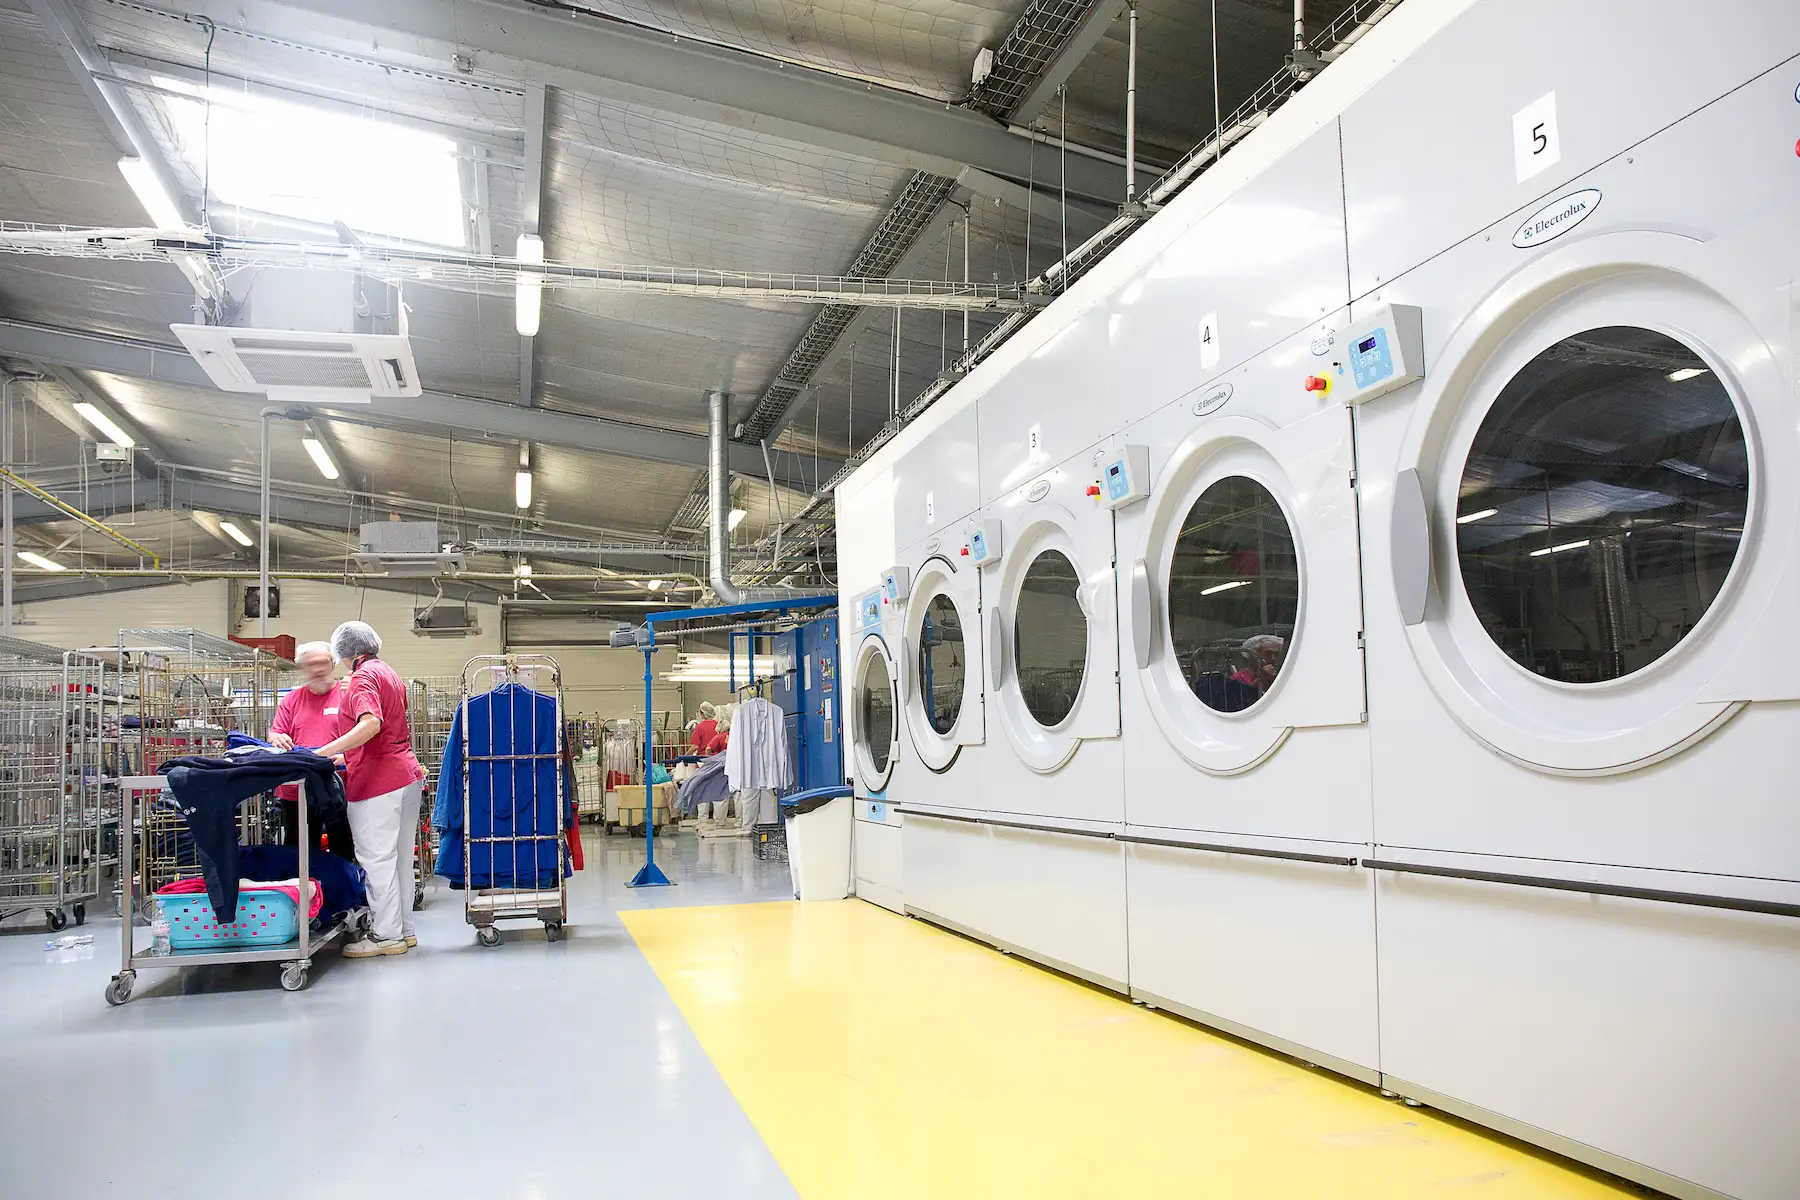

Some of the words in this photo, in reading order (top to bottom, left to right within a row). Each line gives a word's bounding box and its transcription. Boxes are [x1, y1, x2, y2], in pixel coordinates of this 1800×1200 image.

[1533, 122, 1547, 155] 5
[1535, 200, 1587, 234] Electrolux
[1203, 325, 1211, 344] 4
[1031, 432, 1037, 448] 3
